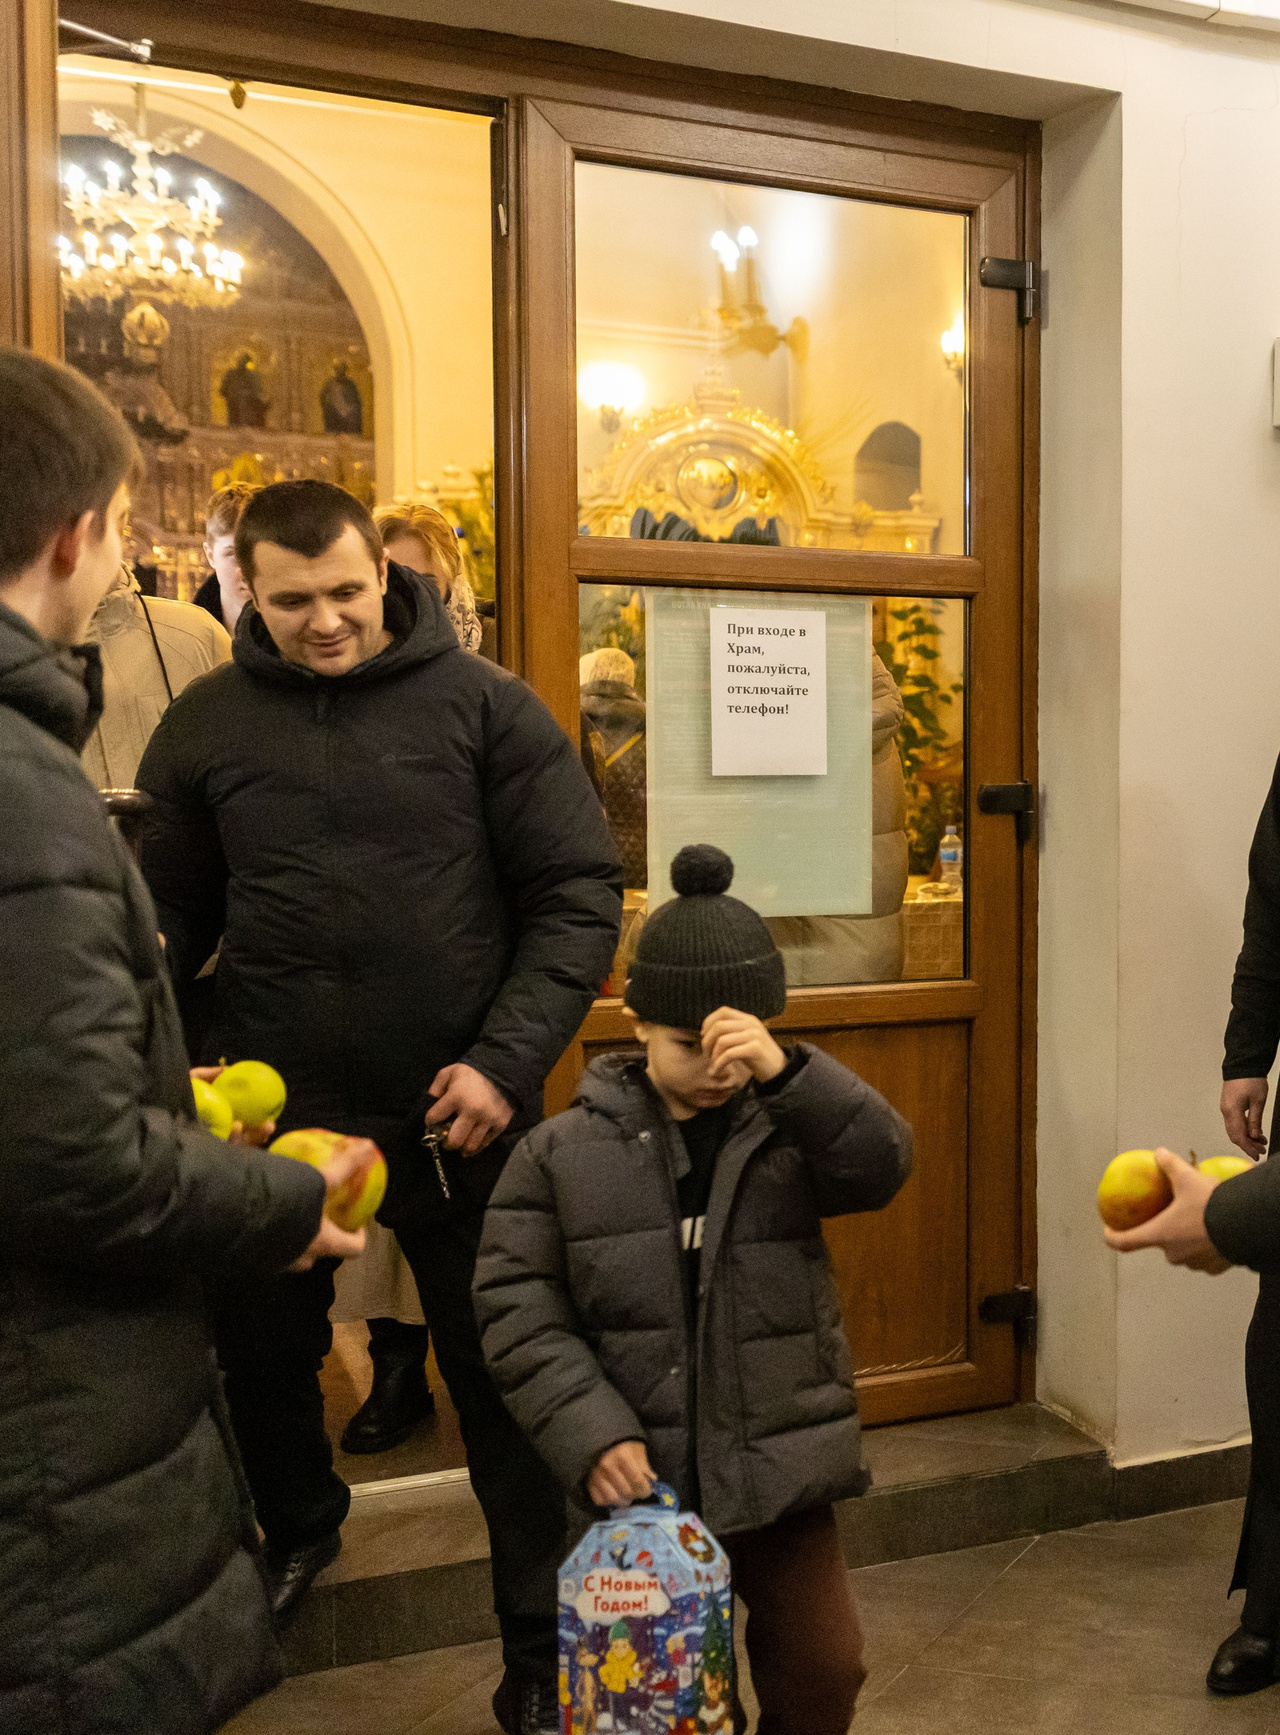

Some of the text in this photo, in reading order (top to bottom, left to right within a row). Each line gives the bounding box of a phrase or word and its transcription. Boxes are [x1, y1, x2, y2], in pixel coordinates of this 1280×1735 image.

[727, 623, 806, 637] При входе в
[727, 642, 765, 656] Храм,
[727, 663, 811, 676] пожалуйста,
[727, 684, 809, 696] отключайте
[727, 703, 789, 716] телефон!
[584, 1575, 658, 1592] С Новым
[594, 1595, 648, 1613] Годом!
